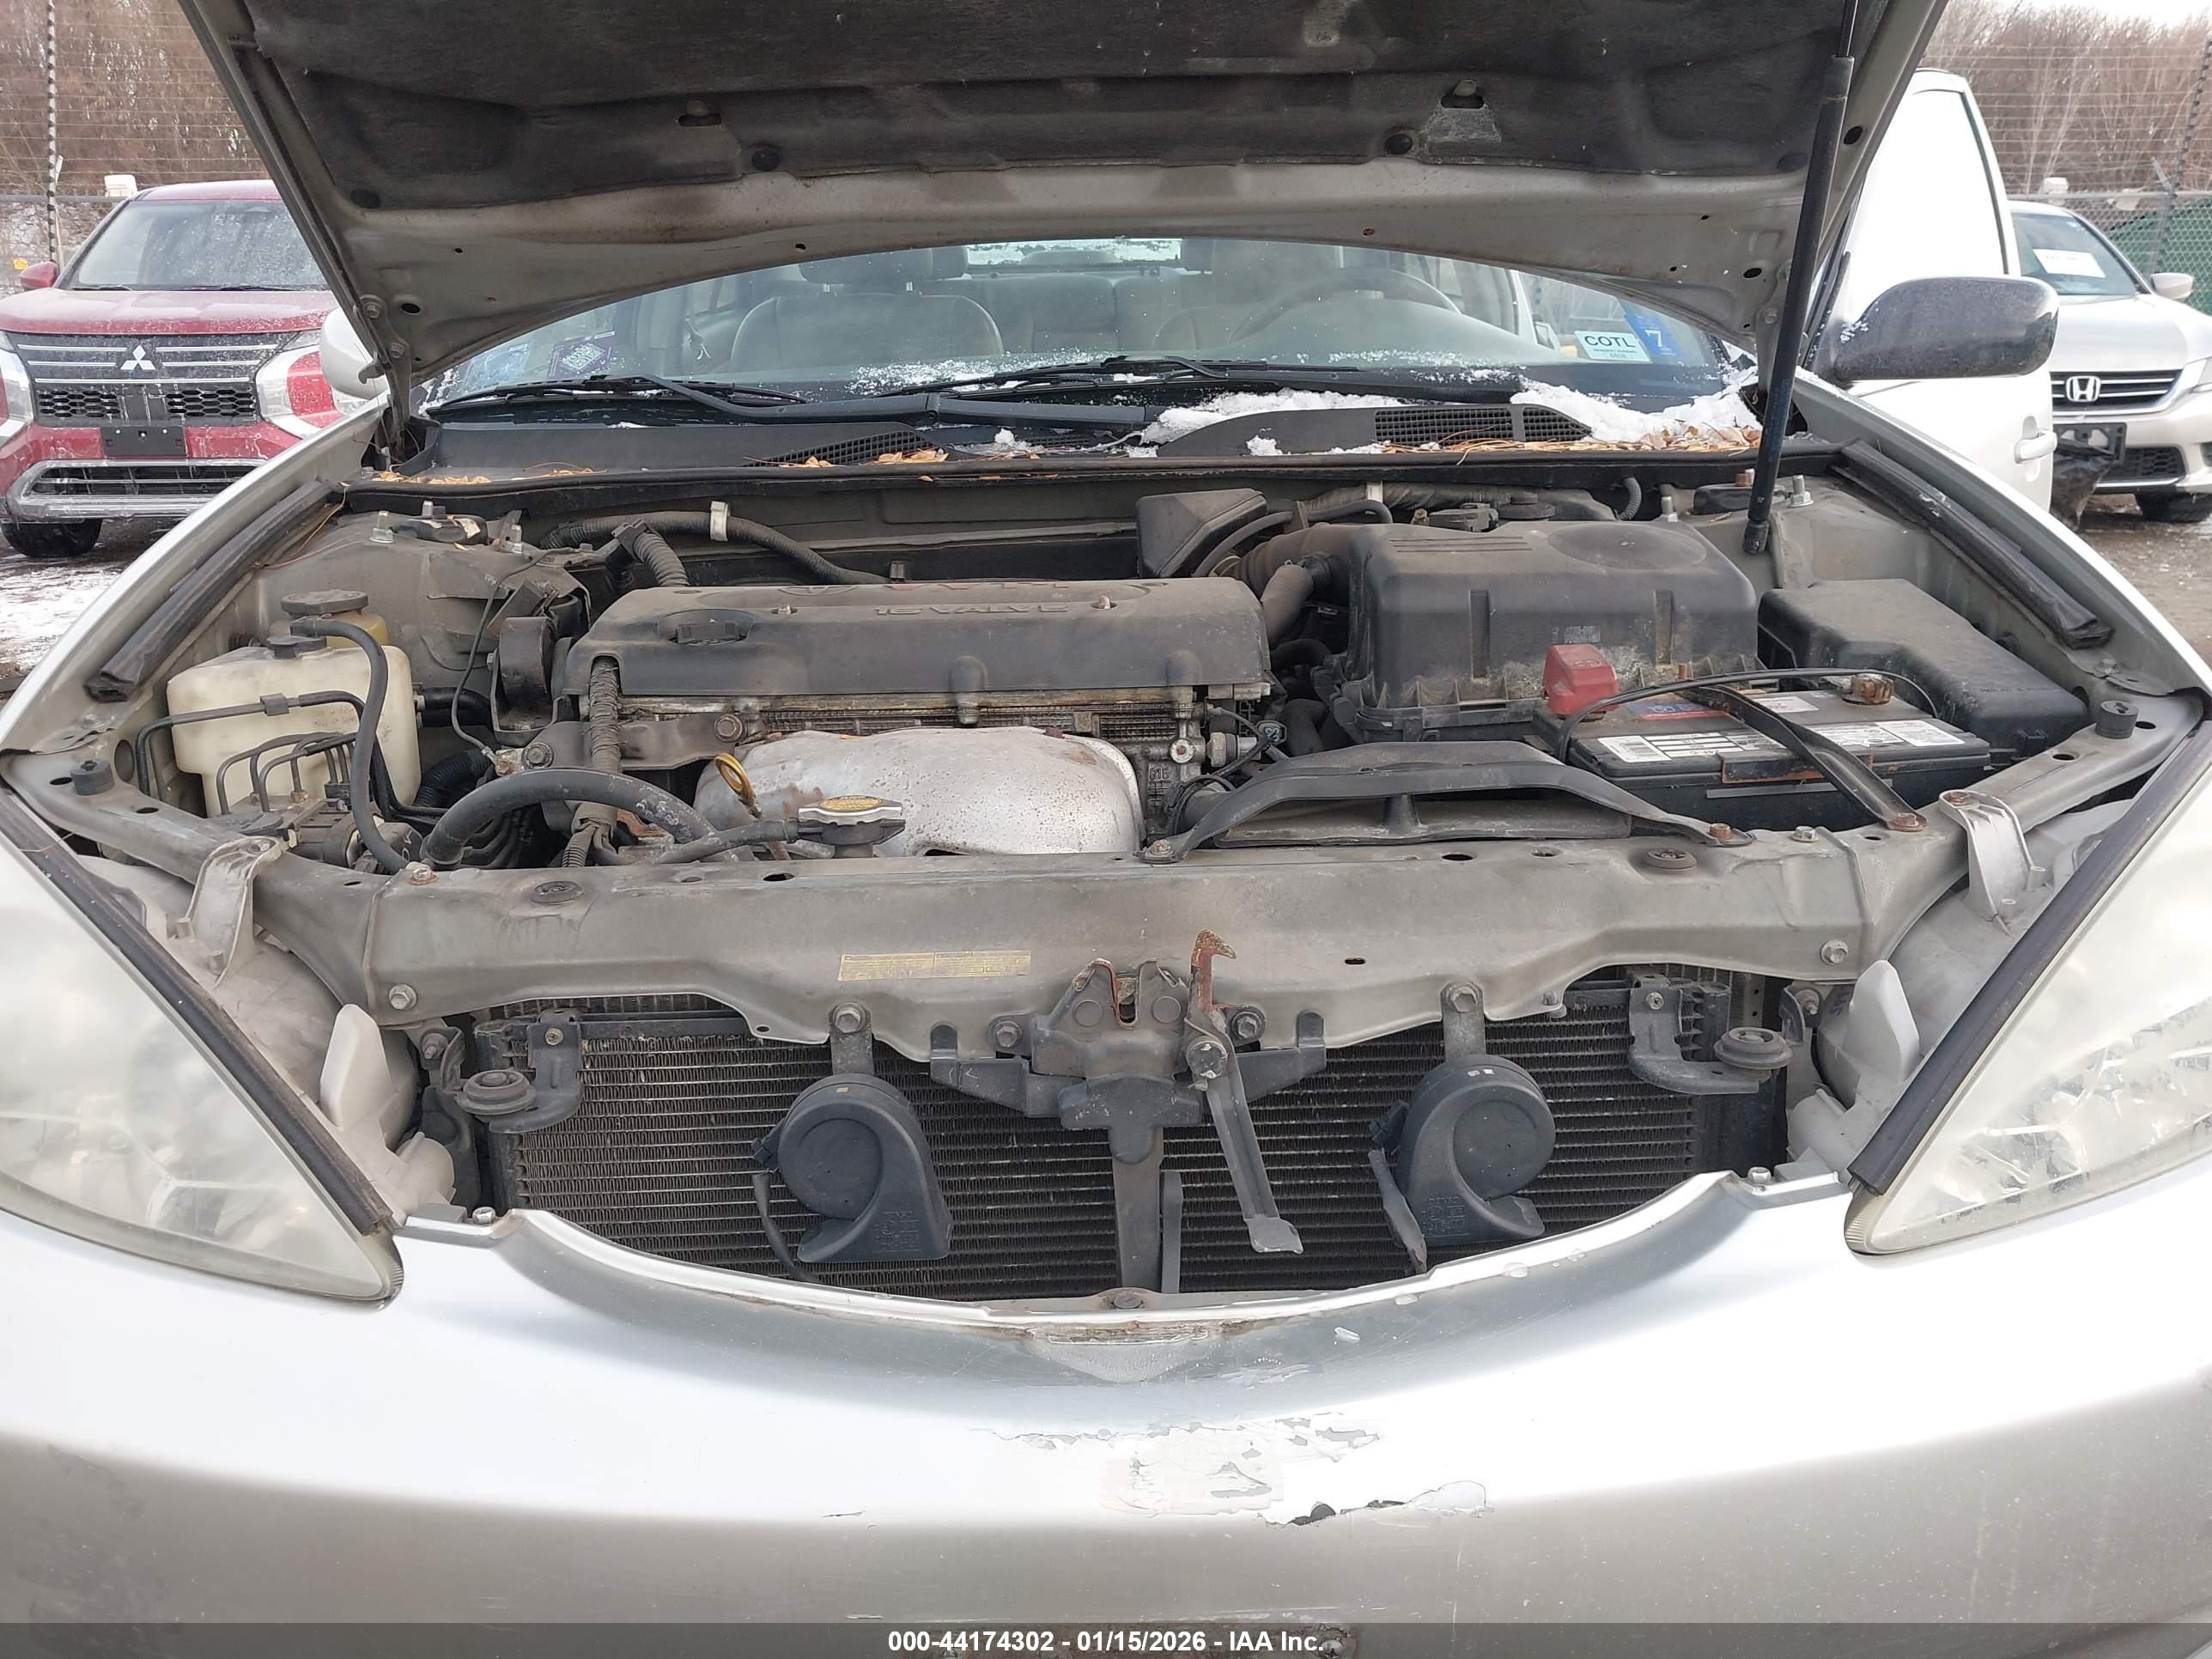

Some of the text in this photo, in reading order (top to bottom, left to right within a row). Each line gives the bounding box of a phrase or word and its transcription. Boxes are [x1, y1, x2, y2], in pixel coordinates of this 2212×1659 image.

[1583, 335, 1637, 348] COTL
[1644, 329, 1662, 348] 7
[929, 605, 1069, 615] VALVE
